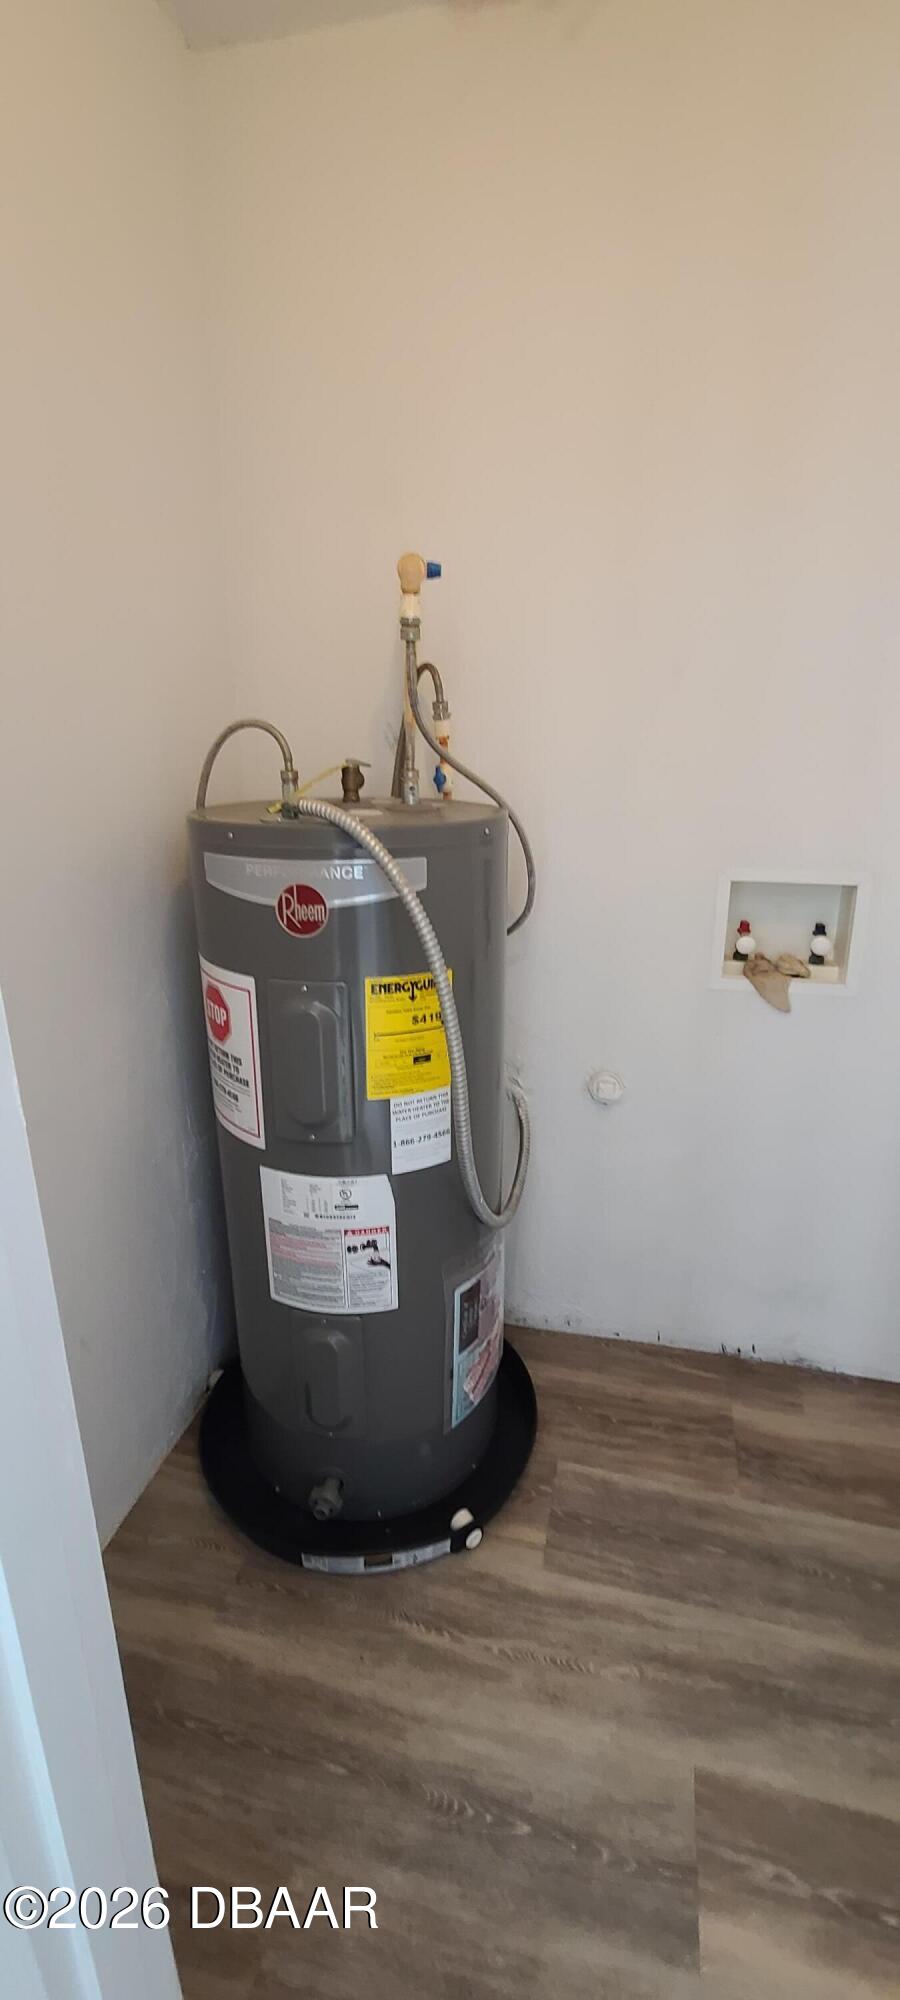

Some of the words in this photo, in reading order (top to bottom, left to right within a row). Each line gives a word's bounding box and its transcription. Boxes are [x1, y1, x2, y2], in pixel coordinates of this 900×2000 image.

[281, 884, 326, 929] Rheem
[371, 978, 436, 996] ENERGYGUI
[206, 998, 227, 1027] STOP
